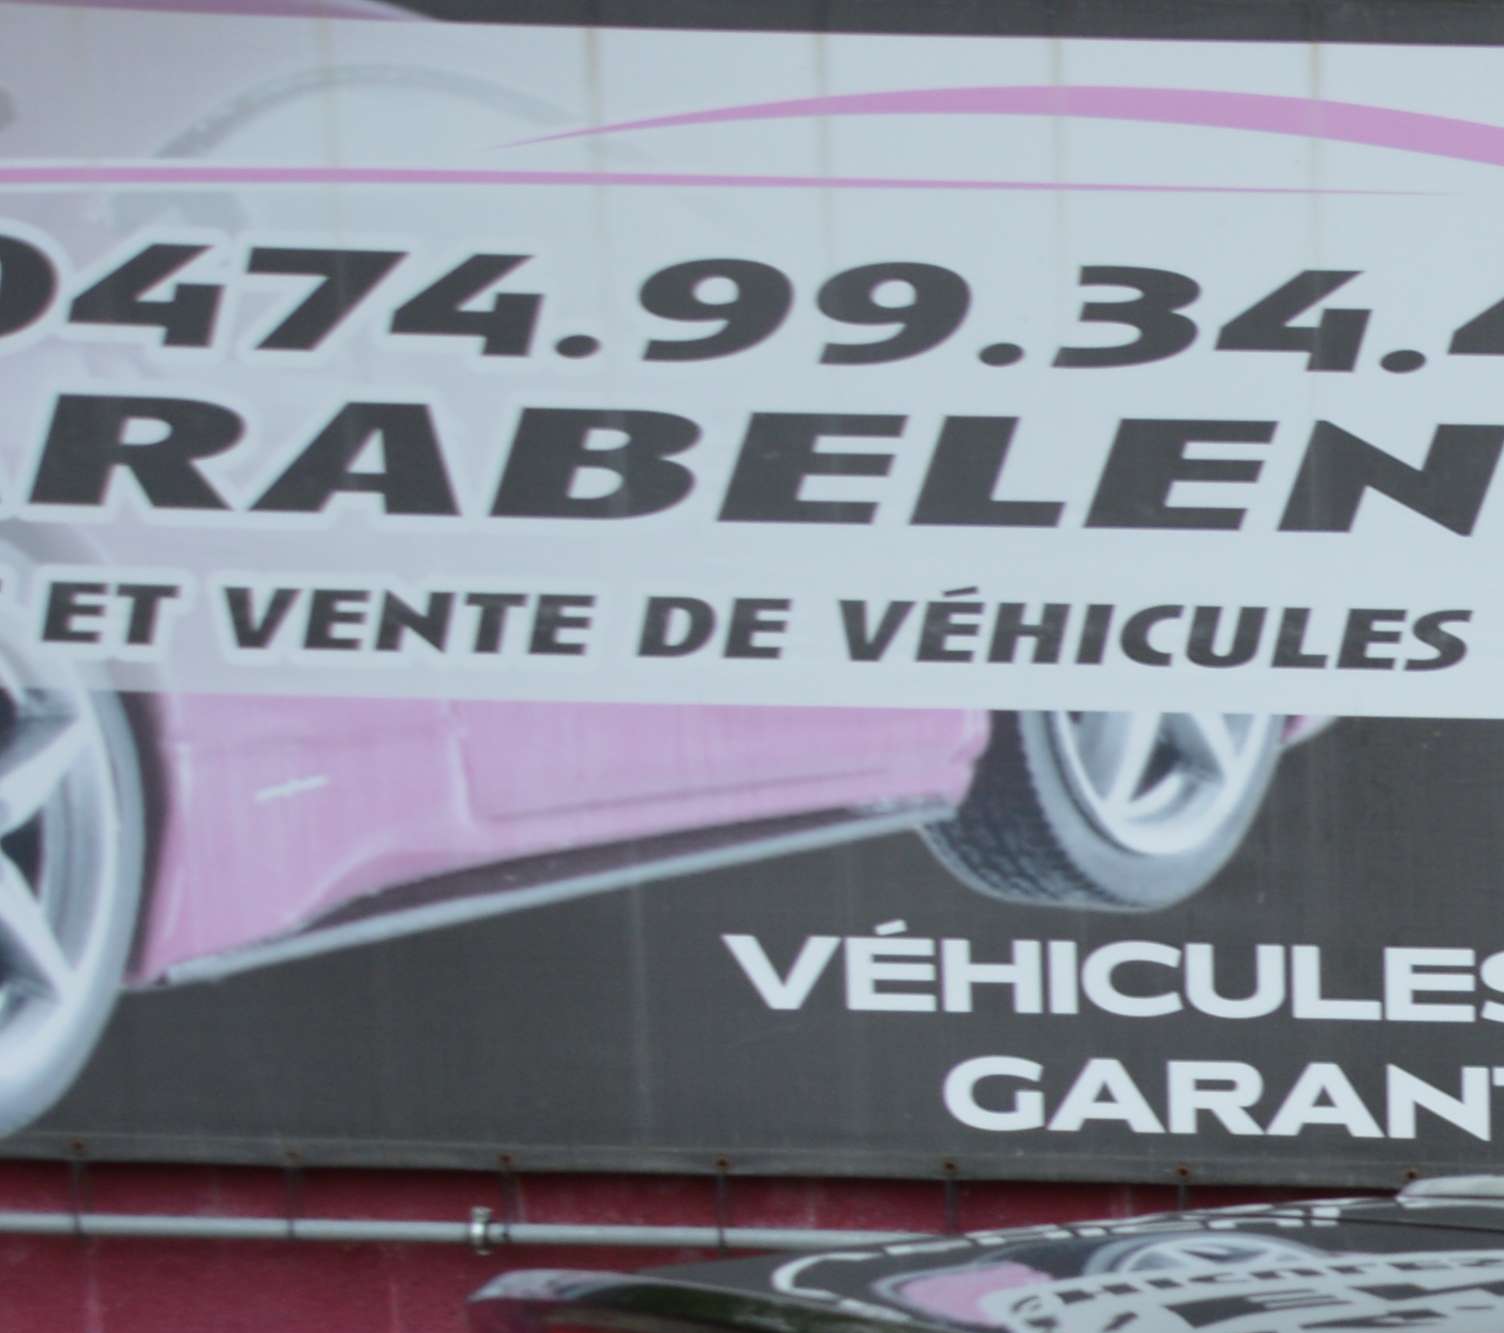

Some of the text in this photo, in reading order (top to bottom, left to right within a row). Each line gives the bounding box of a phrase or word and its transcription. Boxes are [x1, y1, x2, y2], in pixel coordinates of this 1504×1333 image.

[41, 581, 180, 645] ET
[224, 586, 595, 656] VENTE
[637, 596, 791, 659] DE
[839, 586, 1473, 671] VÉHICULES
